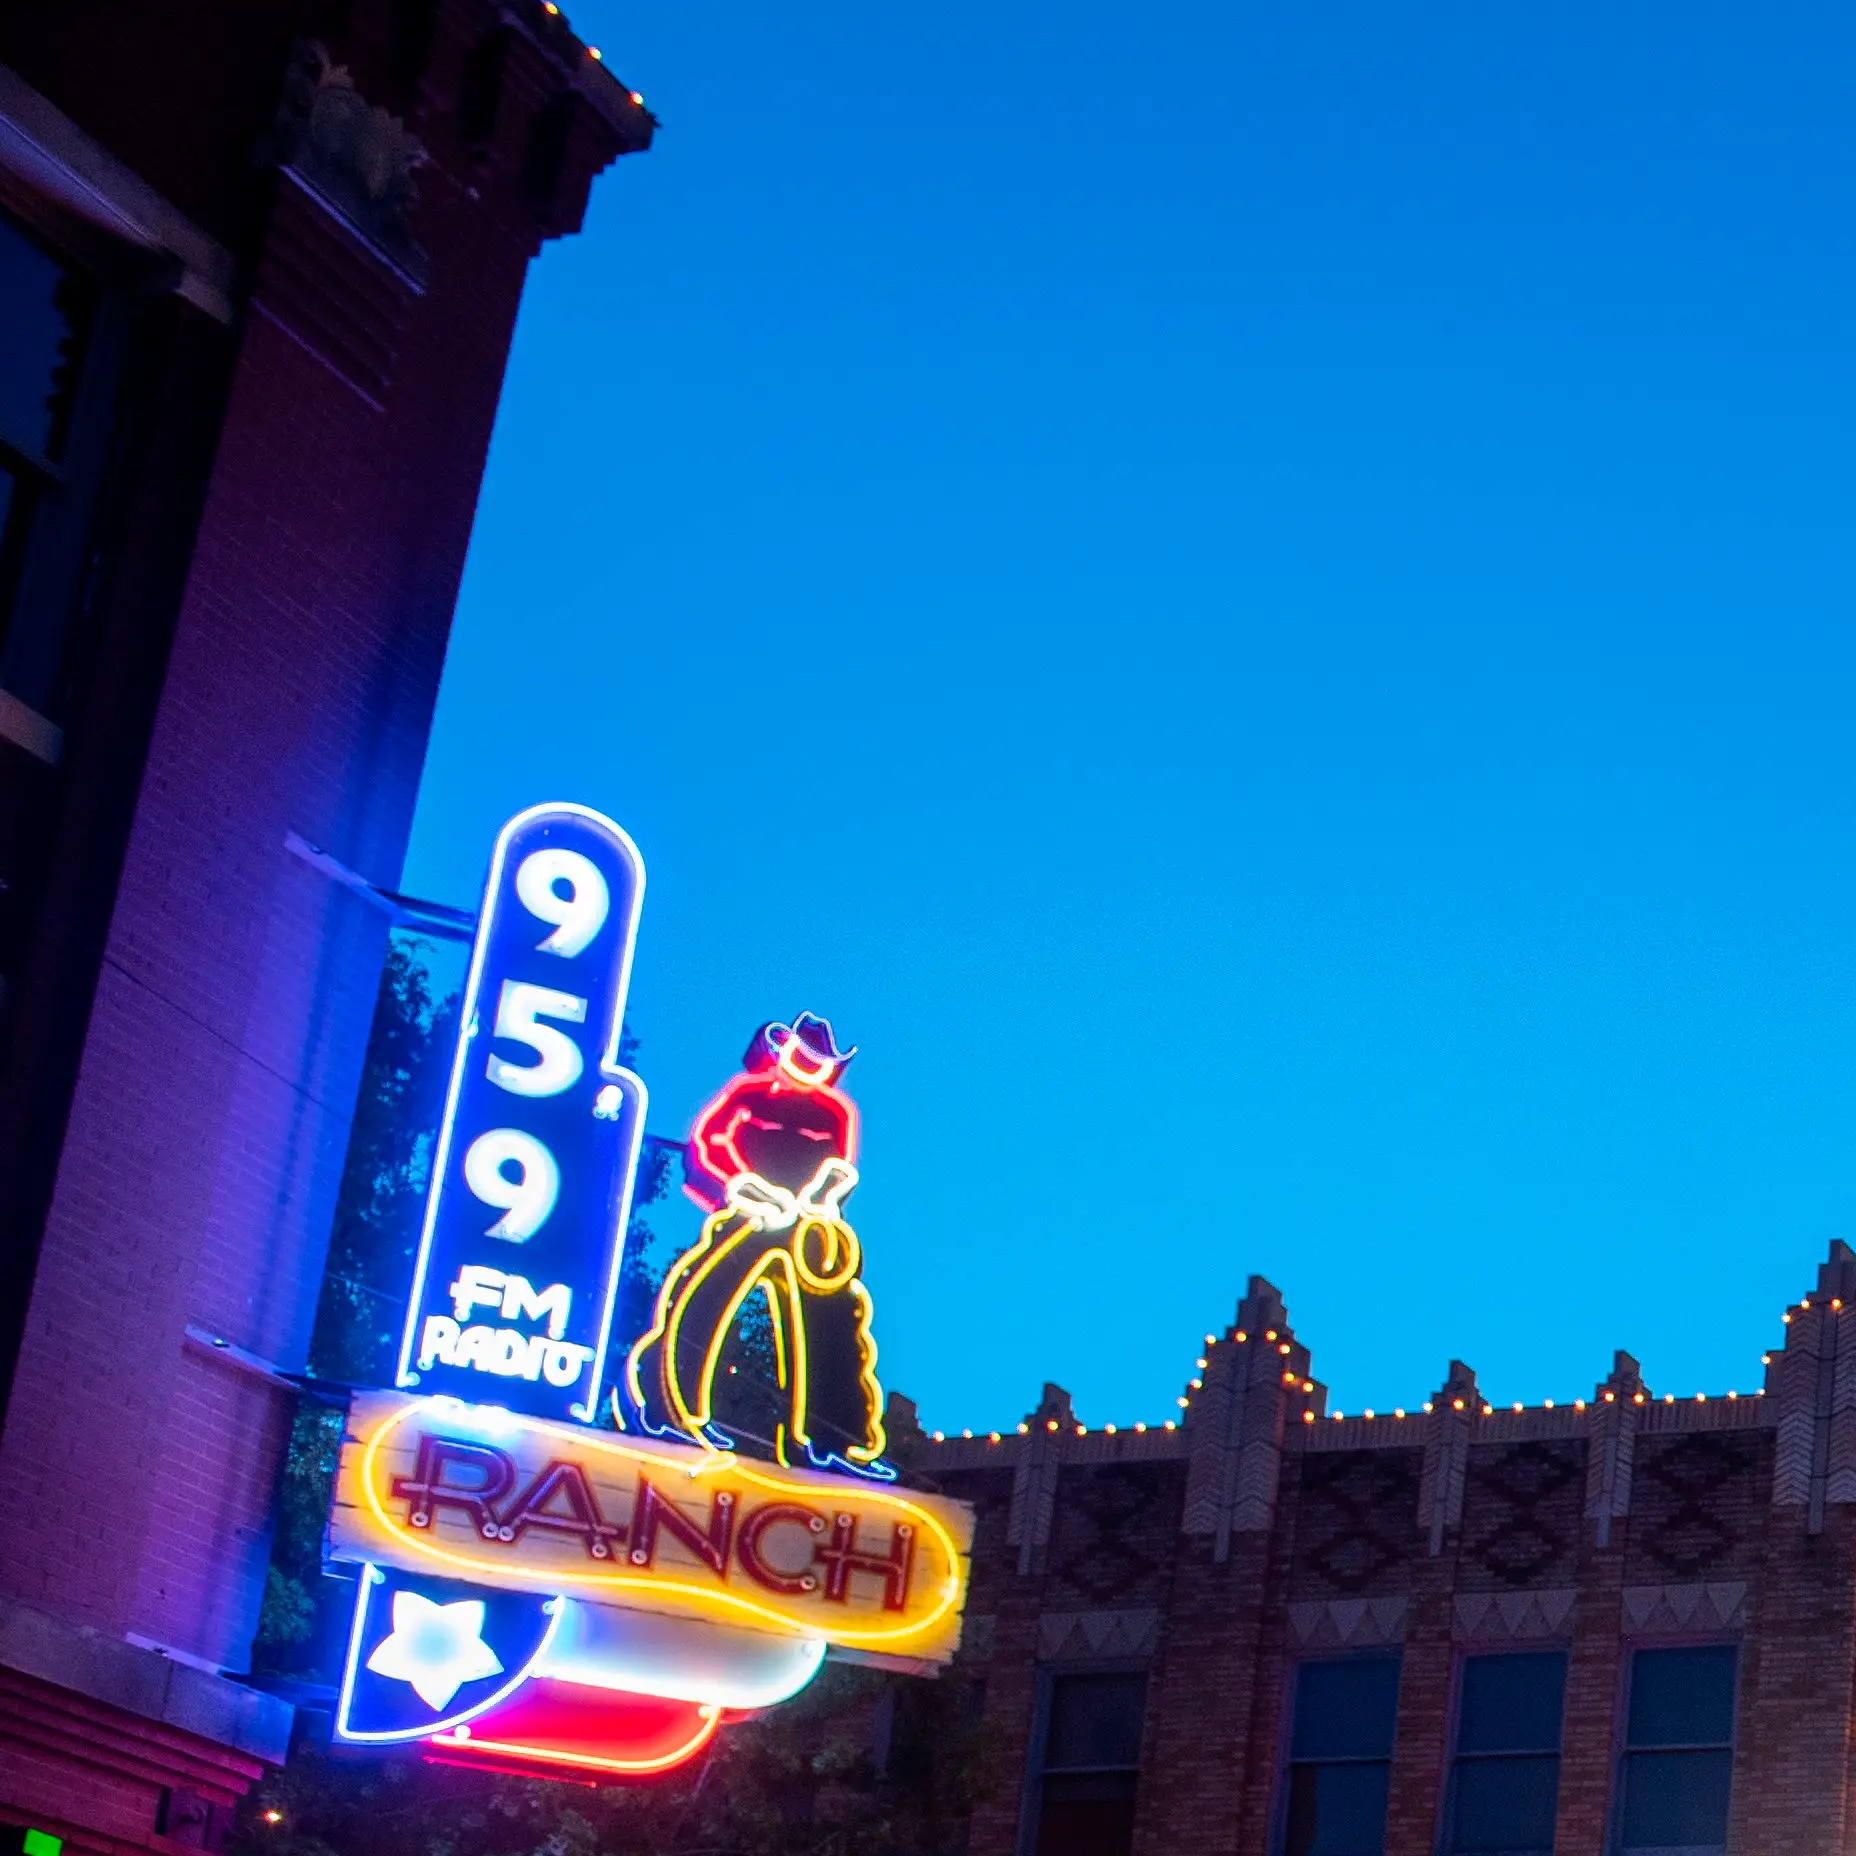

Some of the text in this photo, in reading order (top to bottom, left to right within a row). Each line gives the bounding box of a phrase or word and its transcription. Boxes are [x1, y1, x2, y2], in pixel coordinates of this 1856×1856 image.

[448, 1263, 573, 1339] FM
[417, 1312, 596, 1388] RADIO
[391, 1432, 919, 1614] RANCH
